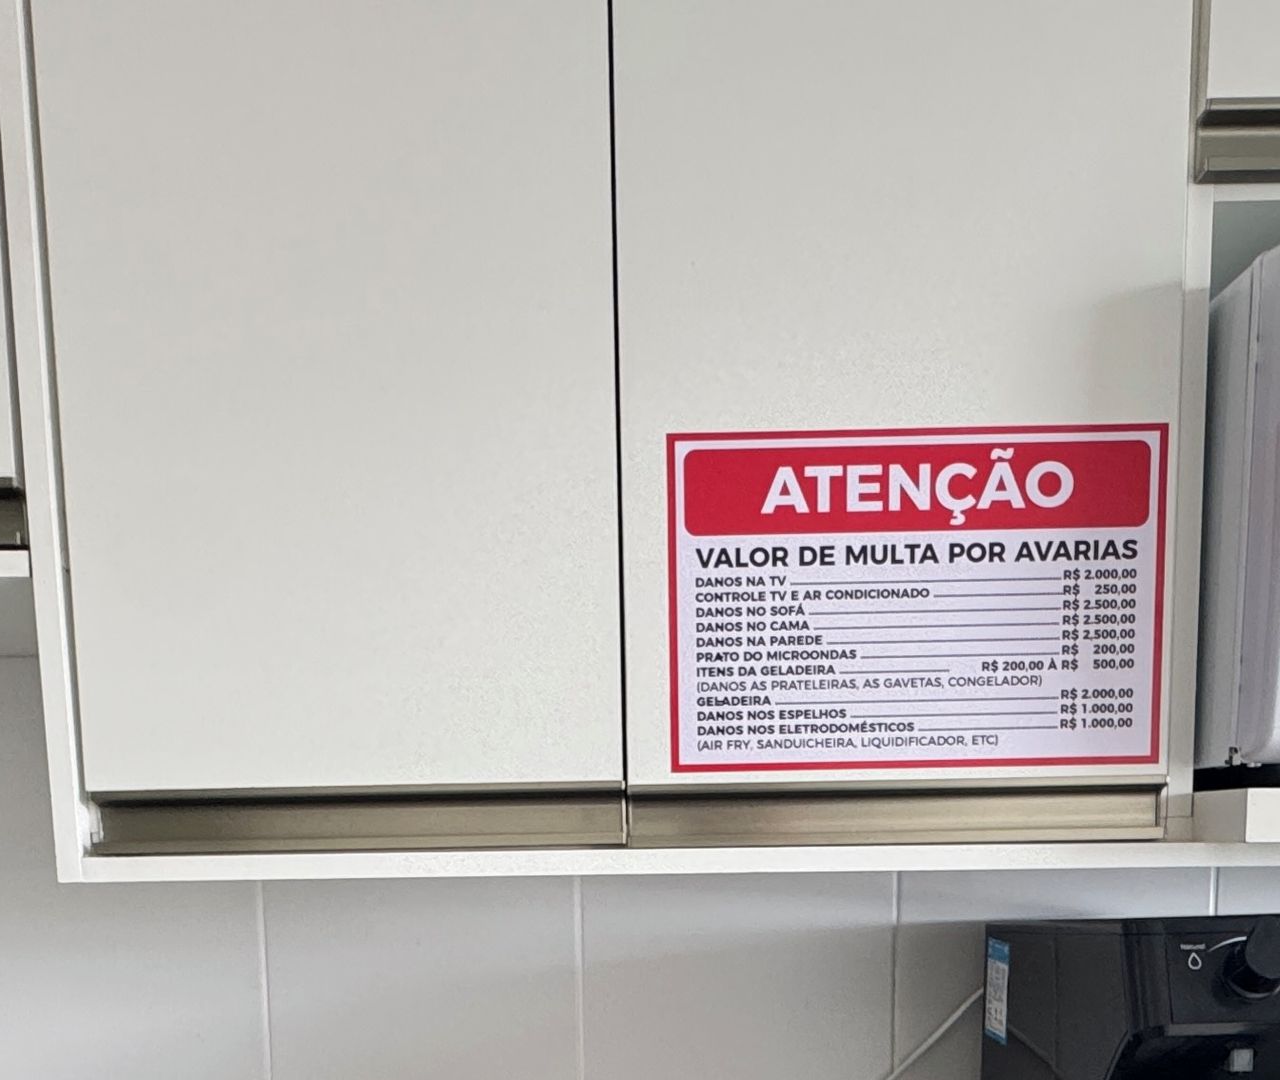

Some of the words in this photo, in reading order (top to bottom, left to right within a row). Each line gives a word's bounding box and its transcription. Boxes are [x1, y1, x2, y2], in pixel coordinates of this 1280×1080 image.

[760, 447, 1075, 526] ATENÇÃO
[696, 546, 788, 569] VALOR
[799, 545, 834, 566] DE
[846, 543, 939, 565] MULTA
[949, 542, 1005, 564] POR
[1014, 538, 1138, 562] AVARIAS
[696, 577, 742, 587] DANOS
[746, 576, 765, 587] NA
[770, 576, 786, 586] TV
[1063, 568, 1080, 582] R$
[1084, 568, 1137, 581] 2.000,00
[696, 592, 766, 602] CONTROLE
[770, 591, 787, 601] TV
[791, 590, 799, 601] E
[803, 590, 821, 600] AR
[825, 588, 930, 600] CONDICIONADO
[1063, 583, 1080, 597] R$
[1095, 584, 1137, 596] 250,00
[696, 607, 742, 617] DANOS
[747, 606, 766, 616] NO
[770, 603, 805, 616] SOFÁ
[1063, 598, 1080, 612] R$
[1084, 599, 1136, 611] 2.500,00
[696, 622, 742, 632] DANOS
[747, 622, 766, 632] NO
[770, 621, 810, 631] CAMA
[1062, 613, 1080, 627] R$
[1083, 614, 1136, 626] 2.500,00
[696, 637, 742, 647] DANOS
[747, 636, 765, 647] NA
[770, 635, 822, 646] PAREDE
[1062, 628, 1079, 642] R$
[696, 652, 739, 662] PRATO
[744, 651, 762, 662] DO
[767, 650, 857, 661] MICROONDAS
[1062, 643, 1079, 657] R$
[1093, 644, 1135, 656] 200,00
[696, 666, 734, 677] ITENS
[738, 666, 756, 676] DA
[760, 664, 836, 676] GELADEIRA
[982, 660, 998, 674] R$
[1002, 660, 1044, 673] 200,00
[1047, 658, 1057, 670] À
[1061, 658, 1078, 672] R$
[1093, 658, 1134, 671] 500,00
[696, 681, 746, 693] (DANOS
[750, 680, 767, 691] AS
[771, 679, 859, 691] PRATELEIRAS,
[862, 678, 880, 689] AS
[883, 677, 944, 689] GAVETAS,
[948, 675, 1042, 687] CONGELADOR)
[697, 696, 771, 707] GELADEIRA
[1060, 687, 1078, 702] R$
[1081, 688, 1133, 701] 2.000,00
[697, 711, 743, 721] DANOS
[747, 710, 775, 721] NOS
[779, 709, 847, 720] ESPELHOS
[1060, 702, 1077, 716] R$
[1082, 703, 1133, 715] 1.000,00
[698, 726, 743, 736] DANOS
[747, 725, 775, 735] NOS
[779, 720, 914, 734] ELETRODOMÉSTICOS
[1060, 717, 1077, 731] R$
[1082, 718, 1133, 730] 1.000,00
[697, 740, 722, 751] (AIR
[727, 739, 753, 750] FRY,
[757, 737, 858, 750] SANDUICHEIRA,
[861, 736, 967, 748] LIQUIDIFICADOR,
[972, 734, 998, 746] ETC)
